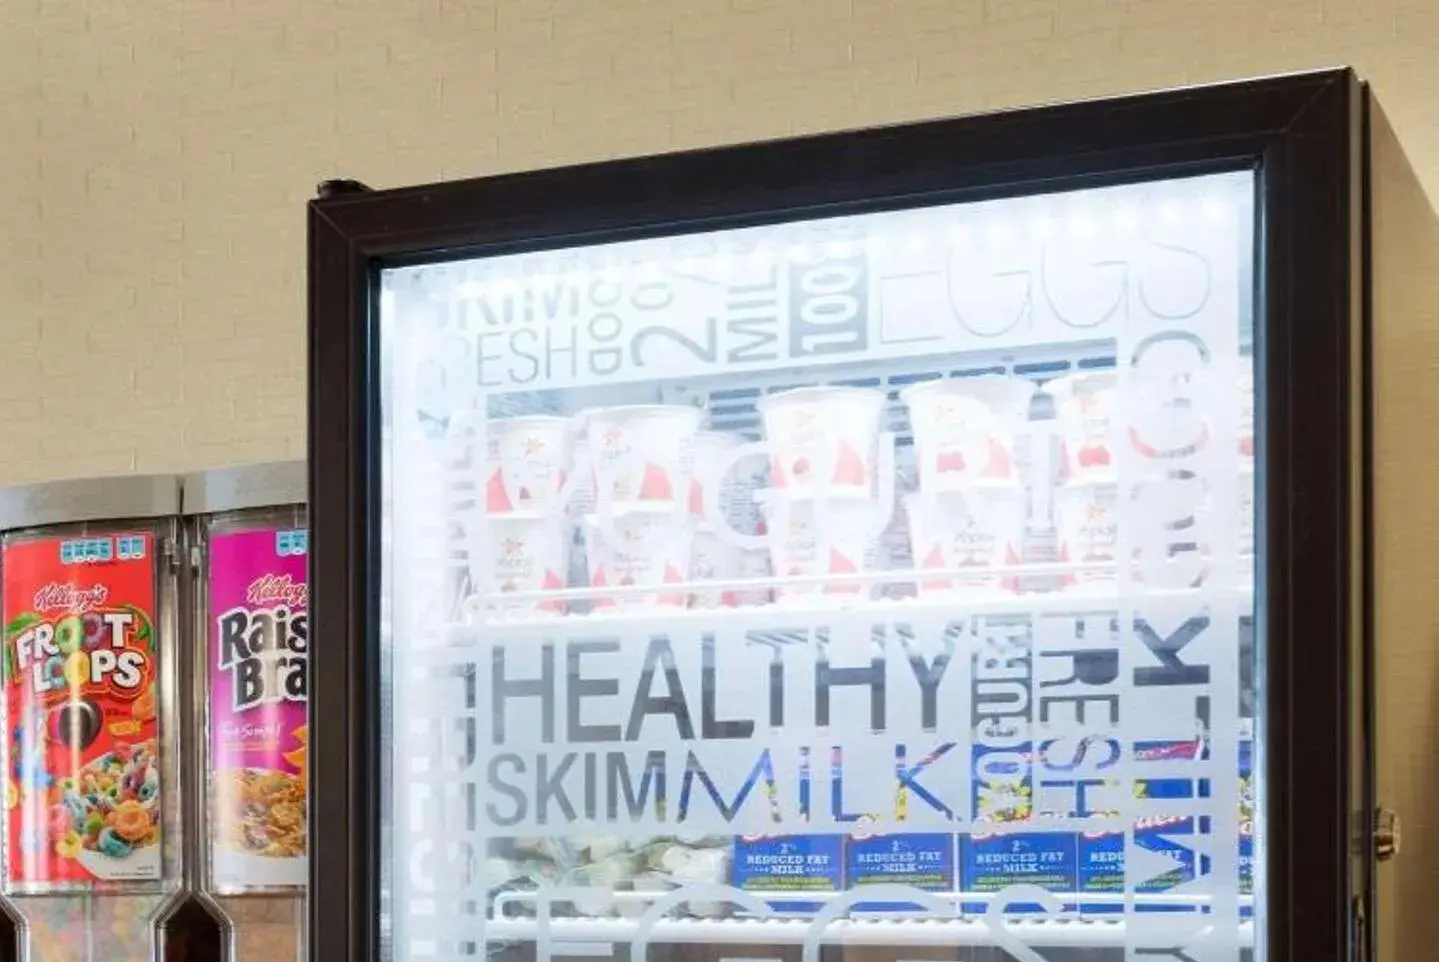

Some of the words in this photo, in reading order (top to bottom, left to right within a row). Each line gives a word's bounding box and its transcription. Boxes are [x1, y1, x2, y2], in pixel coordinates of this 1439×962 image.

[34, 584, 108, 611] Kellogg's
[16, 612, 134, 670] FROOT
[221, 610, 309, 663] Rais
[32, 648, 147, 693] LOOPS
[235, 655, 309, 709] Bra
[491, 622, 964, 745] HEALTHY
[1133, 604, 1212, 915] MILK
[486, 748, 667, 828] SKIM
[676, 742, 963, 825] MILK
[747, 855, 803, 865] REDUCED
[807, 855, 831, 865] FAT
[770, 864, 804, 874] MILK
[858, 853, 916, 863] REDUCED
[919, 851, 942, 861] FAT
[882, 863, 916, 873] MILK
[976, 852, 1037, 864] REDUCED
[1040, 851, 1064, 862] FAT
[1003, 862, 1039, 873] MILK
